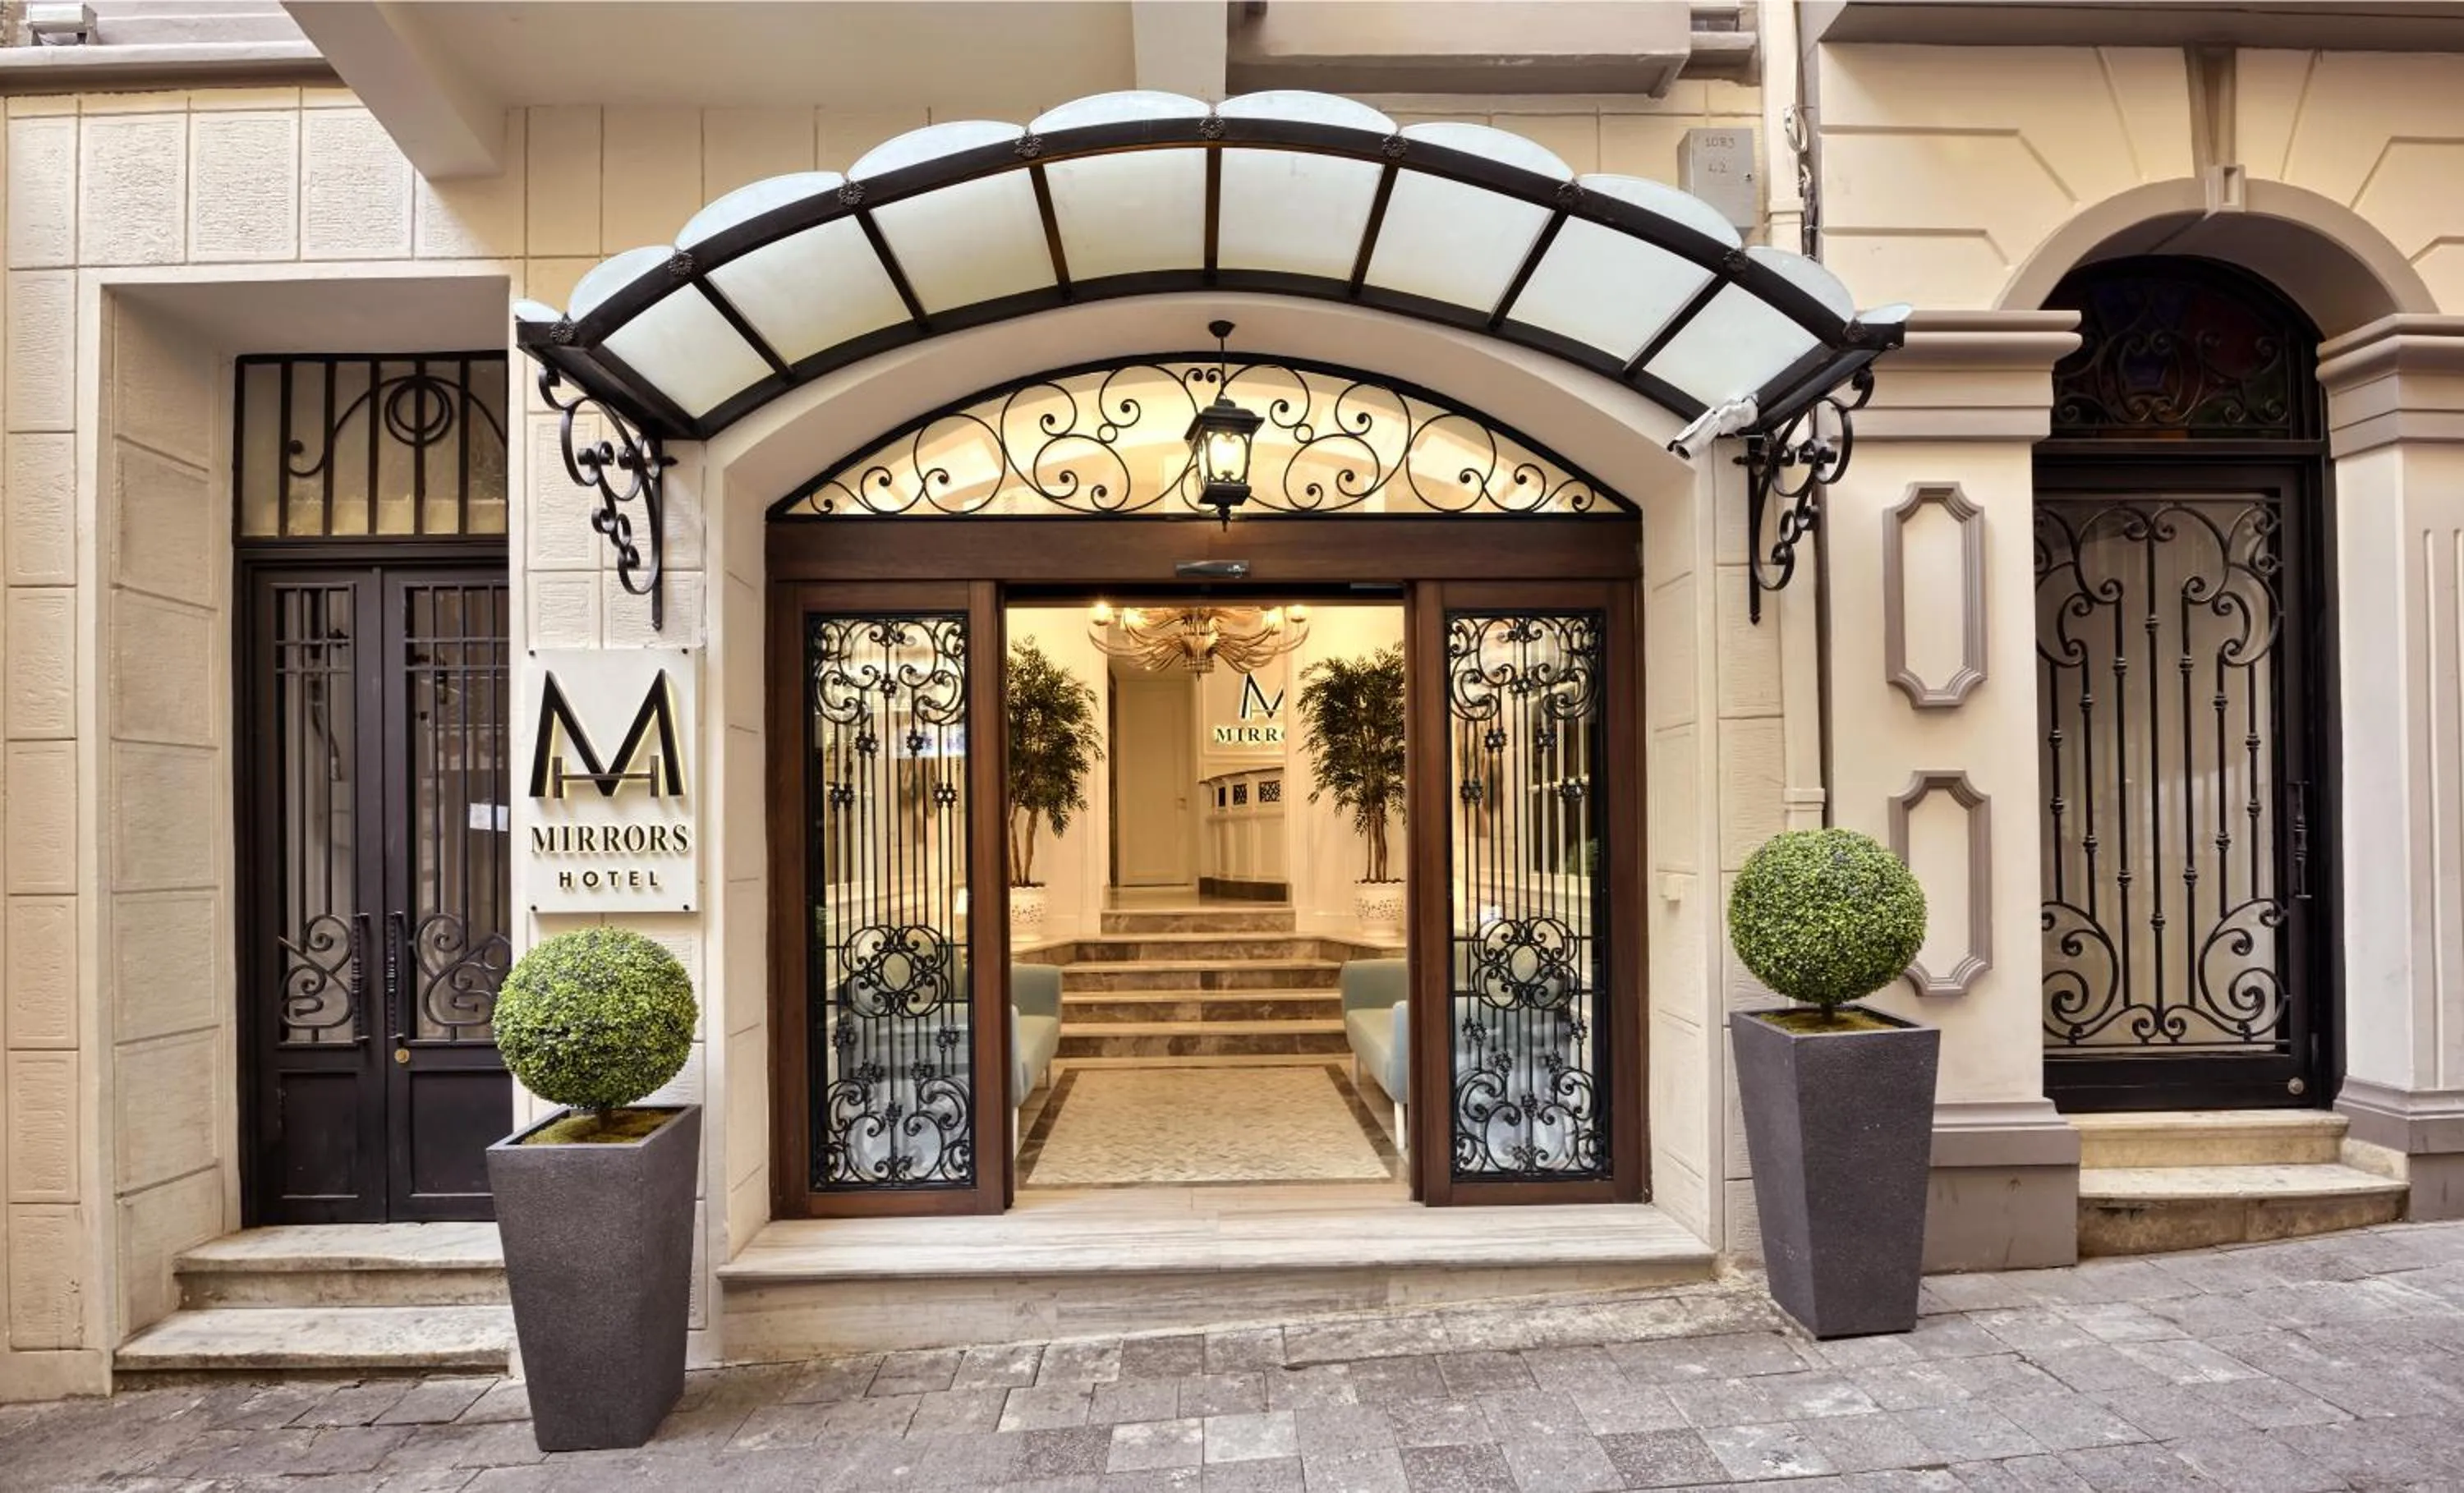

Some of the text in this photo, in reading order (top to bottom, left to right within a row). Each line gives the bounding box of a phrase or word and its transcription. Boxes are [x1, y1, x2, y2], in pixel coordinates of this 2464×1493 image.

[1216, 728, 1285, 742] MIRR
[530, 824, 690, 854] MIRRORS
[559, 871, 660, 889] HOTEL
